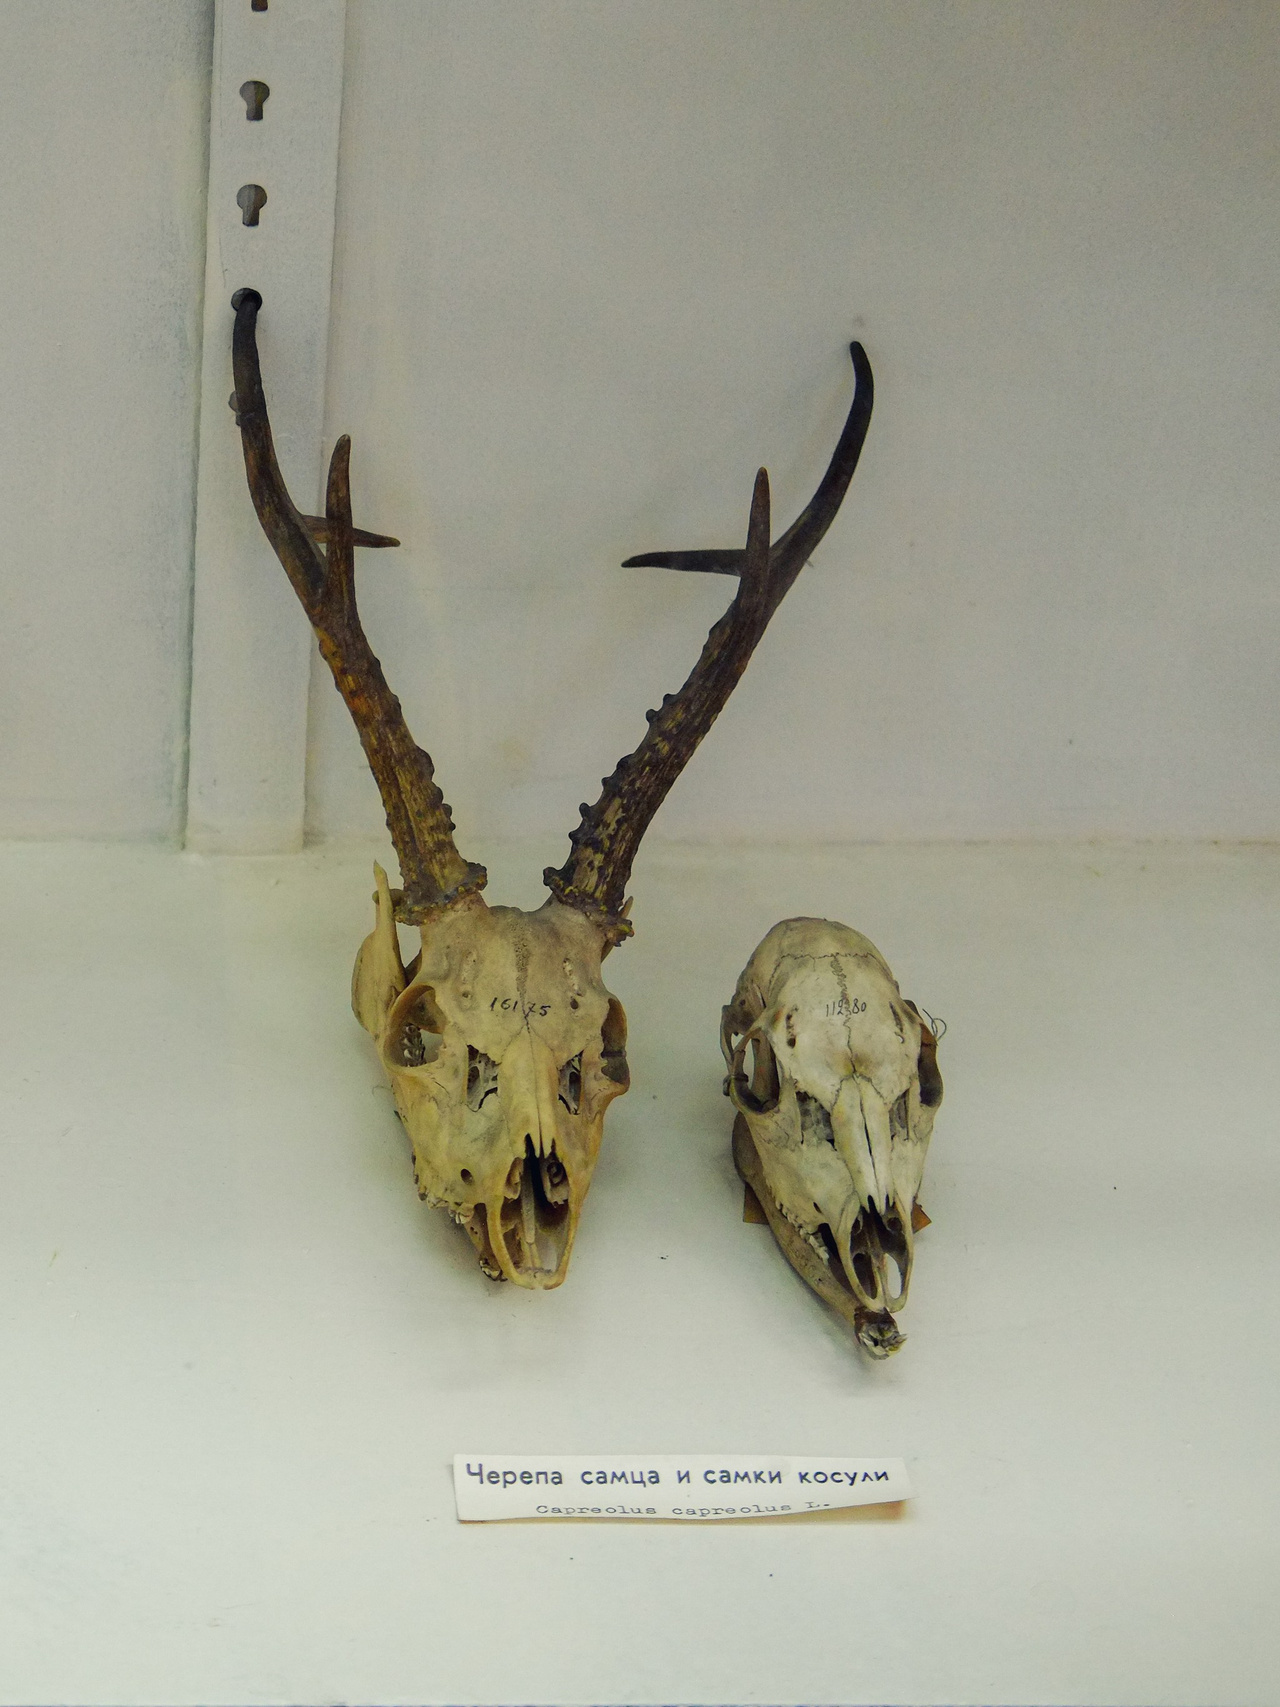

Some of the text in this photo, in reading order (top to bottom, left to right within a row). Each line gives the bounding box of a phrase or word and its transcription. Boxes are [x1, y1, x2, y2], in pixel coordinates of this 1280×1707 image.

[466, 1463, 890, 1489] Черепа самца и самки косули
[536, 1501, 831, 1517] Capreolus capreolus L.
